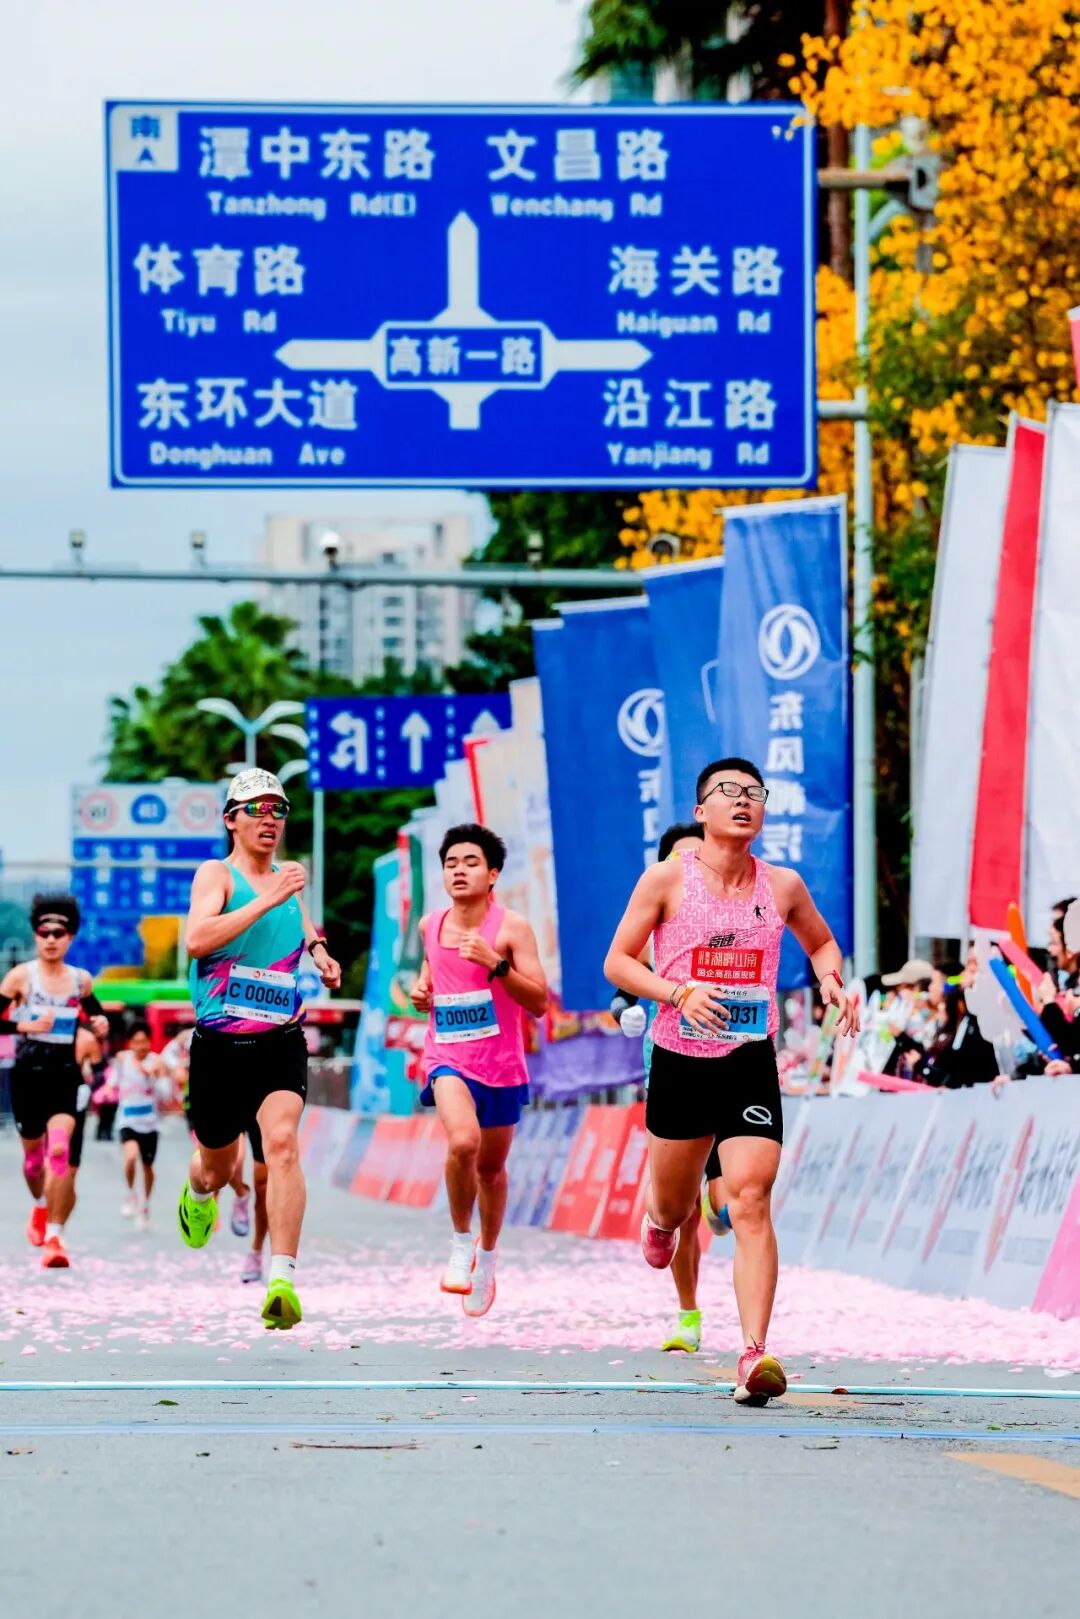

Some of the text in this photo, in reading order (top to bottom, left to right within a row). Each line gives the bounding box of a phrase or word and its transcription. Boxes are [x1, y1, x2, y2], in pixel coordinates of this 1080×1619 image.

[130, 115, 160, 139] 南
[199, 127, 434, 180] 潭中东路
[487, 128, 668, 181] 文昌路
[208, 191, 417, 221] Tanzhong Rd(E)
[491, 193, 662, 222] Wenchang Rd
[134, 243, 305, 296] 体育路
[608, 246, 783, 298] 海关路
[161, 309, 277, 337] Tiyu Rd
[616, 311, 770, 339] Haiguan Rd
[389, 336, 536, 376] 高新一路
[138, 378, 358, 430] 东环大道
[603, 379, 777, 430] 沿江路
[150, 442, 345, 470] Donghuan Ave
[607, 442, 769, 470] Yanjiang Rd
[229, 982, 290, 1008] C 00066
[435, 1006, 488, 1027] C 00102
